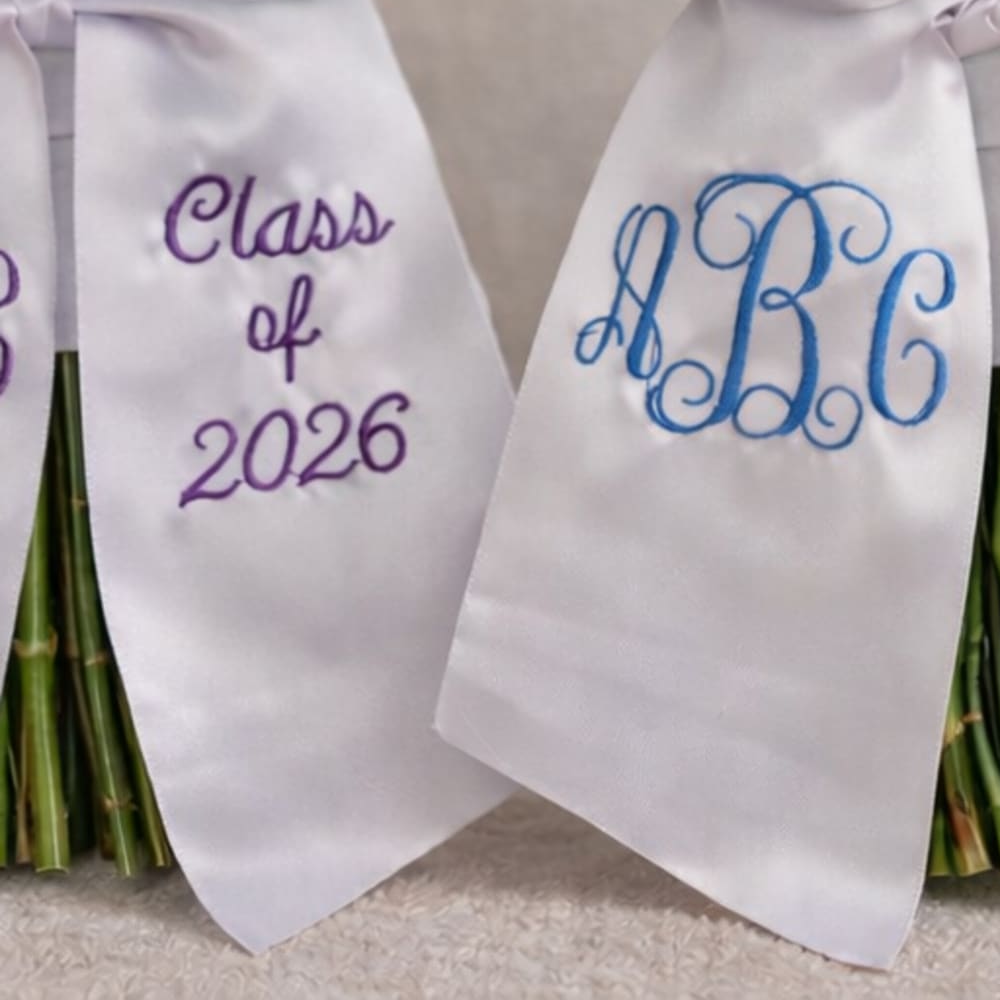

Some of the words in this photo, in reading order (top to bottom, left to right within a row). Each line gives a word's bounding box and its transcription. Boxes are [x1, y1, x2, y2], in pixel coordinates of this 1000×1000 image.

[164, 174, 394, 264] Class
[247, 275, 321, 383] of
[575, 172, 957, 451] ABC
[179, 391, 410, 508] 2026
